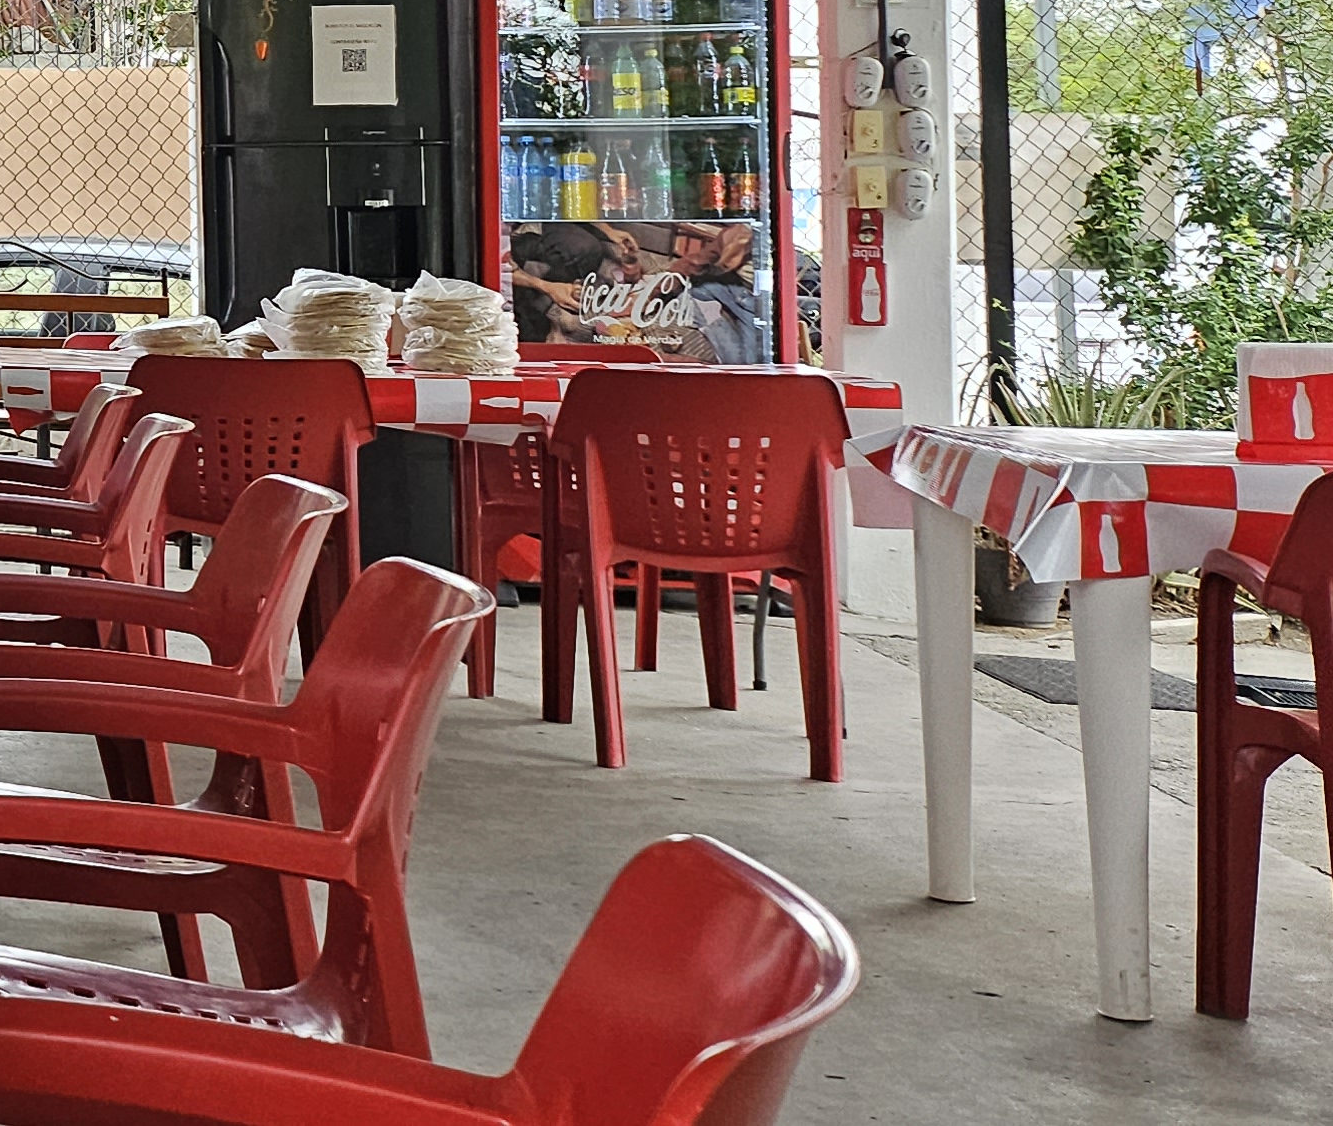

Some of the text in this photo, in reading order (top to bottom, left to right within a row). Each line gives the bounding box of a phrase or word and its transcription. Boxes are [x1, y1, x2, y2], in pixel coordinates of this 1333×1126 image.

[593, 334, 683, 345] Magia de Verdad
